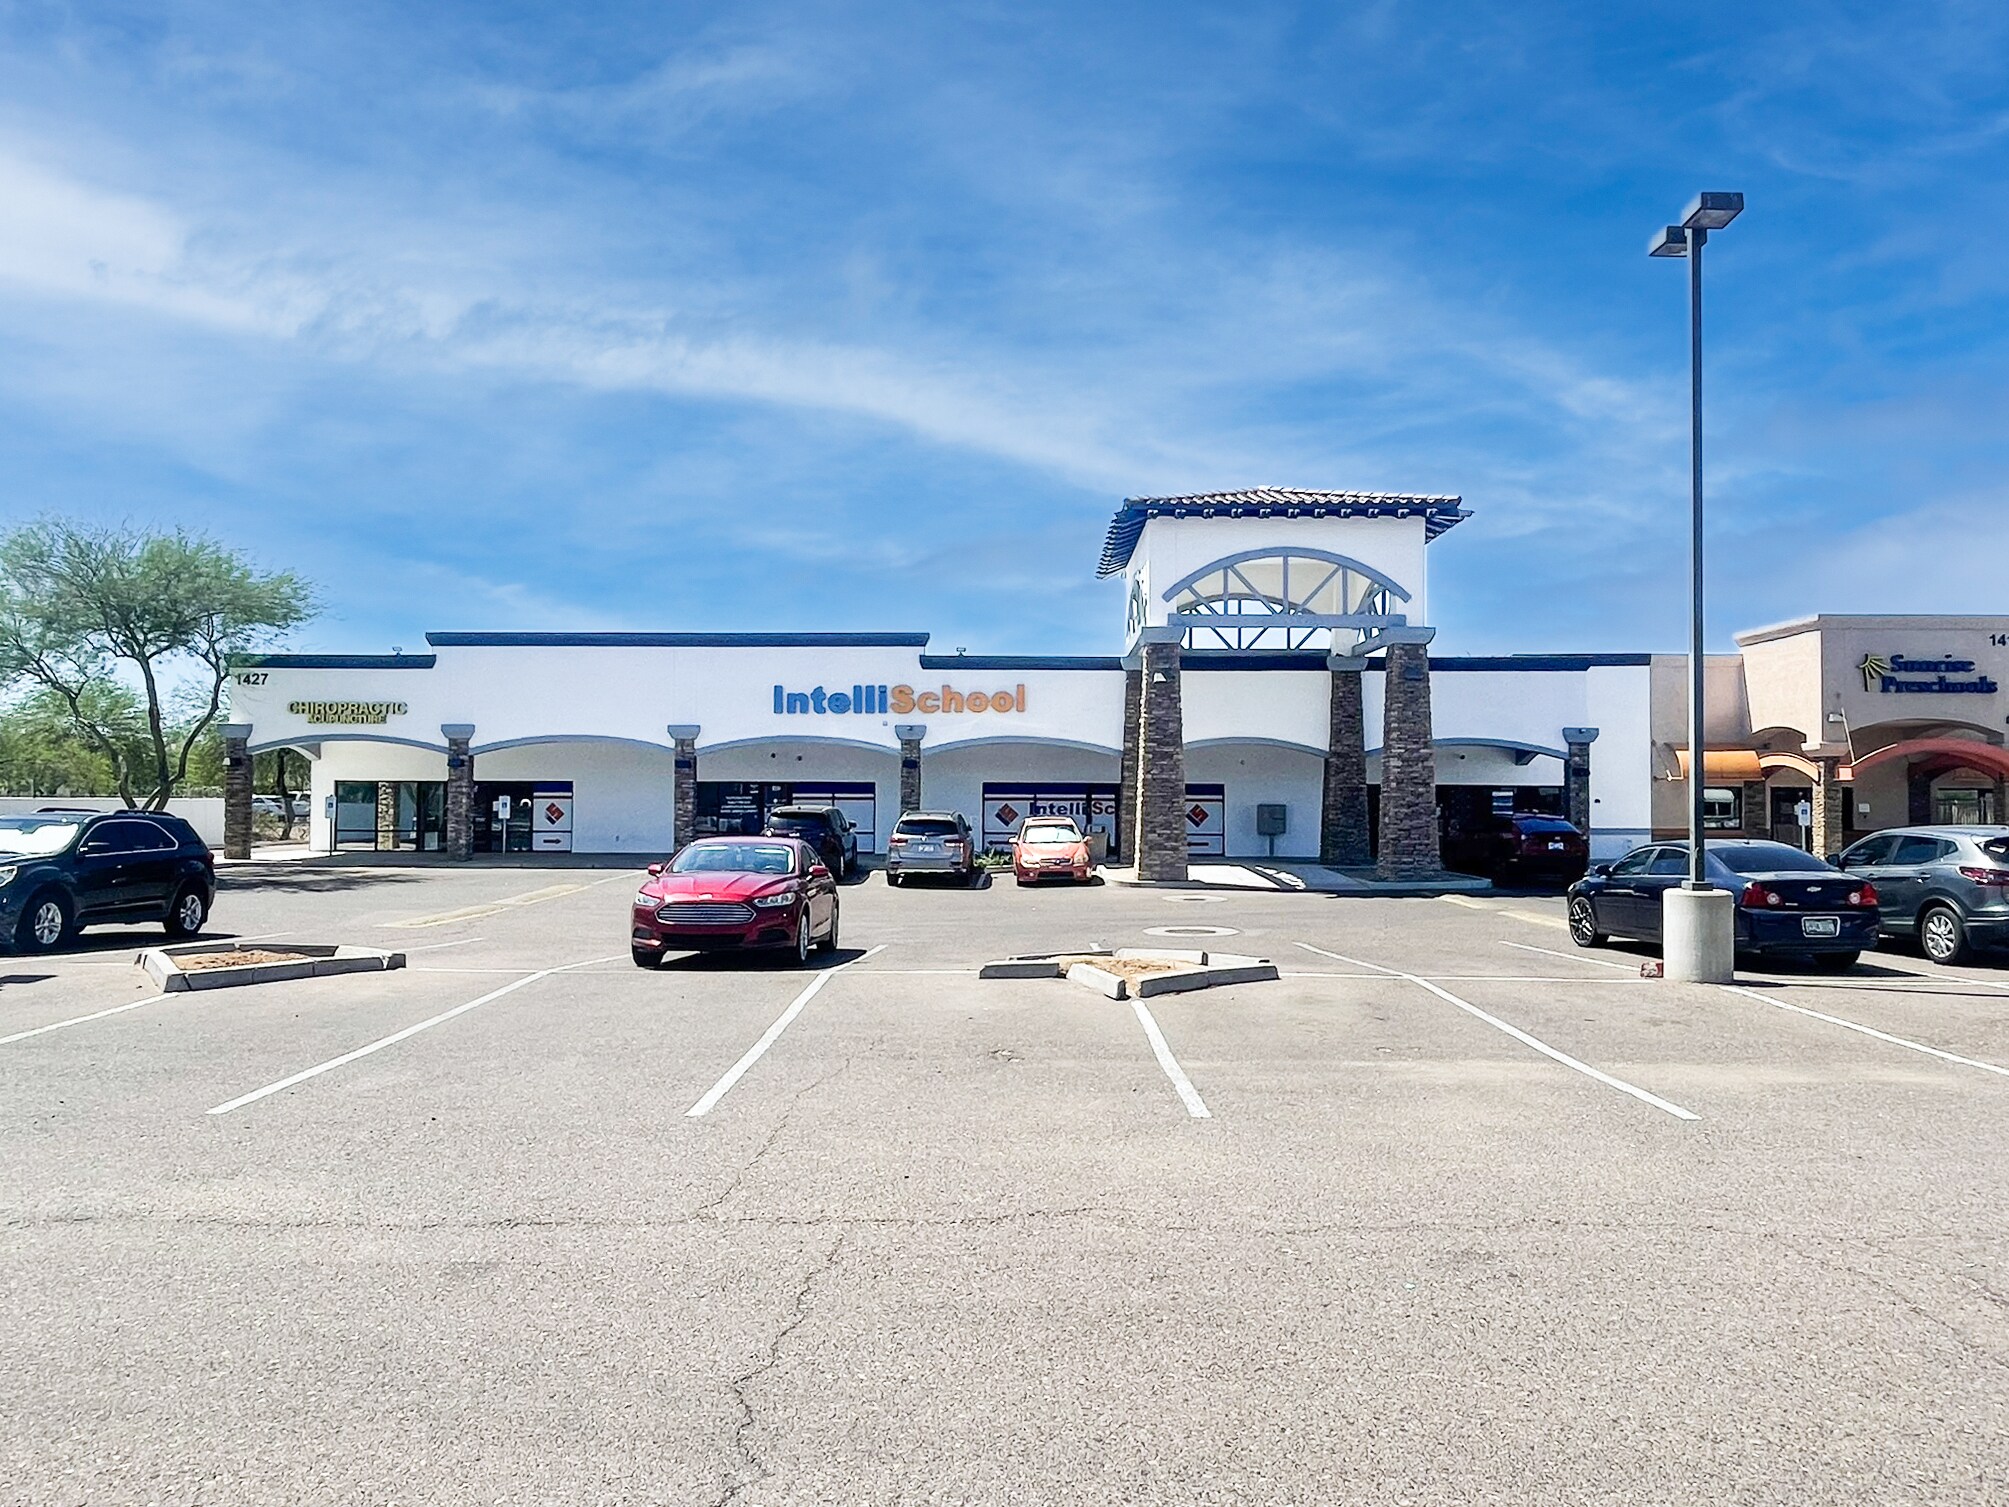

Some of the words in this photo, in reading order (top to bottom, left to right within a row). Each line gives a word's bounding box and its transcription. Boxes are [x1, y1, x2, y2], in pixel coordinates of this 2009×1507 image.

[236, 673, 269, 686] 1427
[773, 684, 1026, 714] IntelliSchool
[288, 701, 408, 715] CHIROPRACTIC
[307, 714, 388, 724] ACUPUNCTURE
